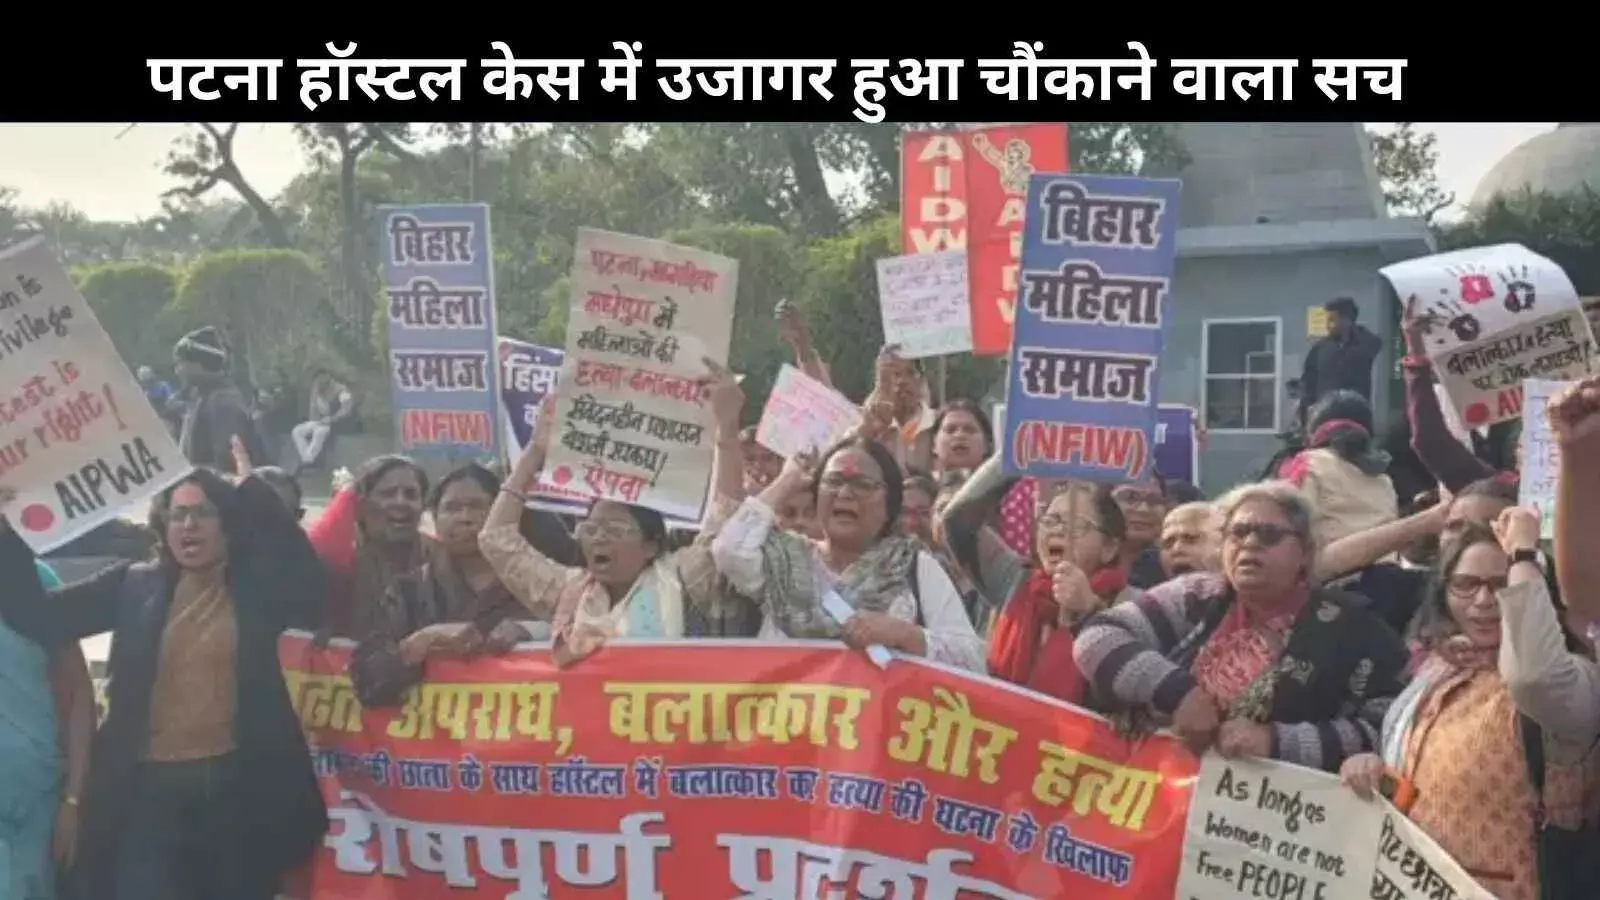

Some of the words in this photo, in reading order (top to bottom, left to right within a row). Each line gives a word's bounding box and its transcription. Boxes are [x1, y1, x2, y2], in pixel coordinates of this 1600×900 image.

[390, 214, 472, 263] बिहार
[1040, 180, 1164, 248] बिहार
[386, 278, 486, 328] महिला
[1022, 260, 1168, 328] महिला
[392, 351, 487, 391] समाज
[1018, 348, 1156, 405] समाज
[400, 411, 494, 451] (NFIW)
[1012, 420, 1147, 480] (NFIW)
[54, 436, 164, 519] AIPWA
[386, 683, 574, 756] अपराध,
[604, 682, 870, 750] बलात्कार
[888, 688, 1017, 784] और
[1033, 742, 1162, 831] हत्या
[456, 754, 482, 791] के
[489, 764, 539, 794] साथ
[548, 757, 626, 798] हॉस्टल
[634, 756, 662, 798] में
[667, 763, 778, 799] बलात्कार
[829, 774, 883, 813] हत्या
[891, 780, 926, 823] की
[934, 796, 1001, 841] घटना
[1008, 813, 1037, 855] के
[1045, 823, 1132, 887] खिलाफ
[1215, 768, 1249, 800] As
[1257, 776, 1302, 833] long
[1305, 803, 1326, 824] as
[1197, 851, 1233, 882] Free
[1205, 811, 1272, 853] Women
[1277, 841, 1311, 865] are
[1315, 850, 1346, 877] not
